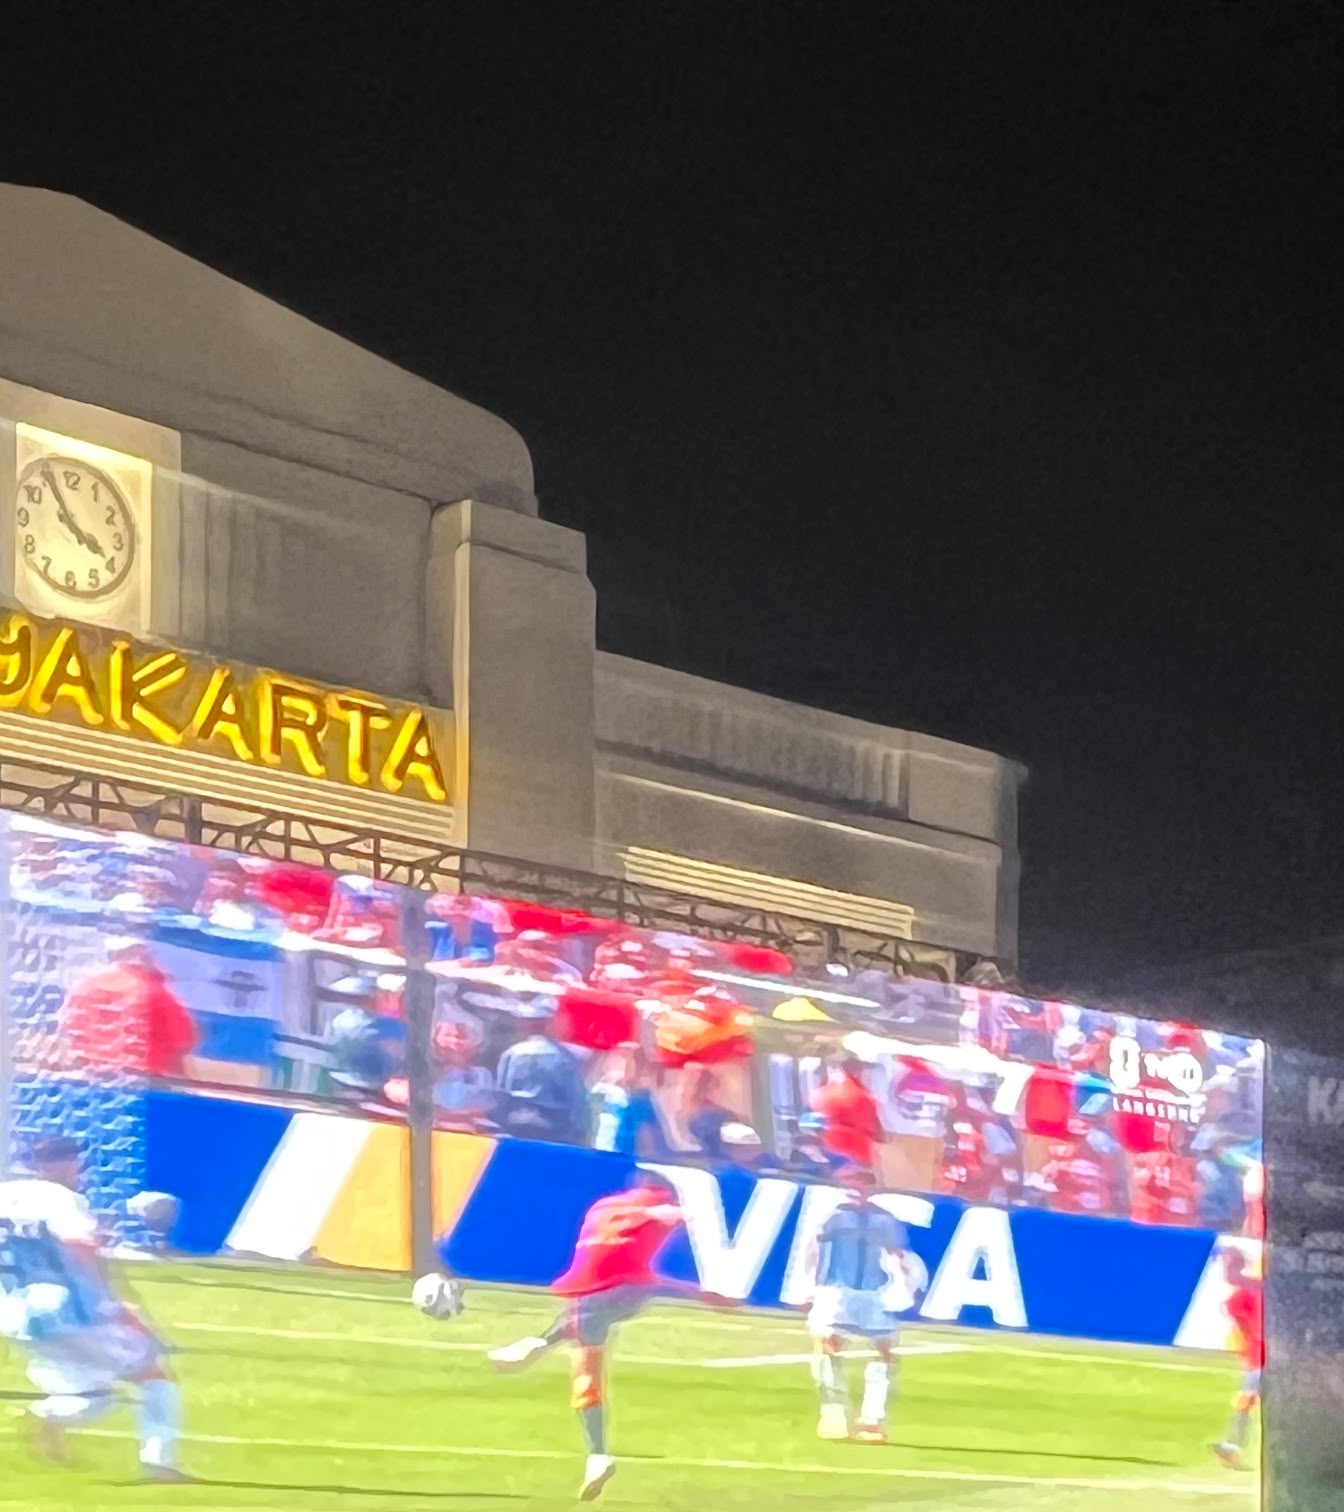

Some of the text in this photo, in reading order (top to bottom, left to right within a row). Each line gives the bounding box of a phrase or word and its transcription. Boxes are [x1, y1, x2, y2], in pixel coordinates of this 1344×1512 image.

[63, 471, 81, 490] 12
[23, 484, 42, 505] 10
[90, 482, 100, 502] 1
[17, 507, 30, 528] 9
[105, 505, 117, 527] 2
[23, 534, 36, 554] 8
[112, 532, 124, 551] 3
[41, 555, 52, 577] 7
[105, 556, 116, 574] 4
[64, 570, 77, 589] 6
[88, 568, 100, 589] 5
